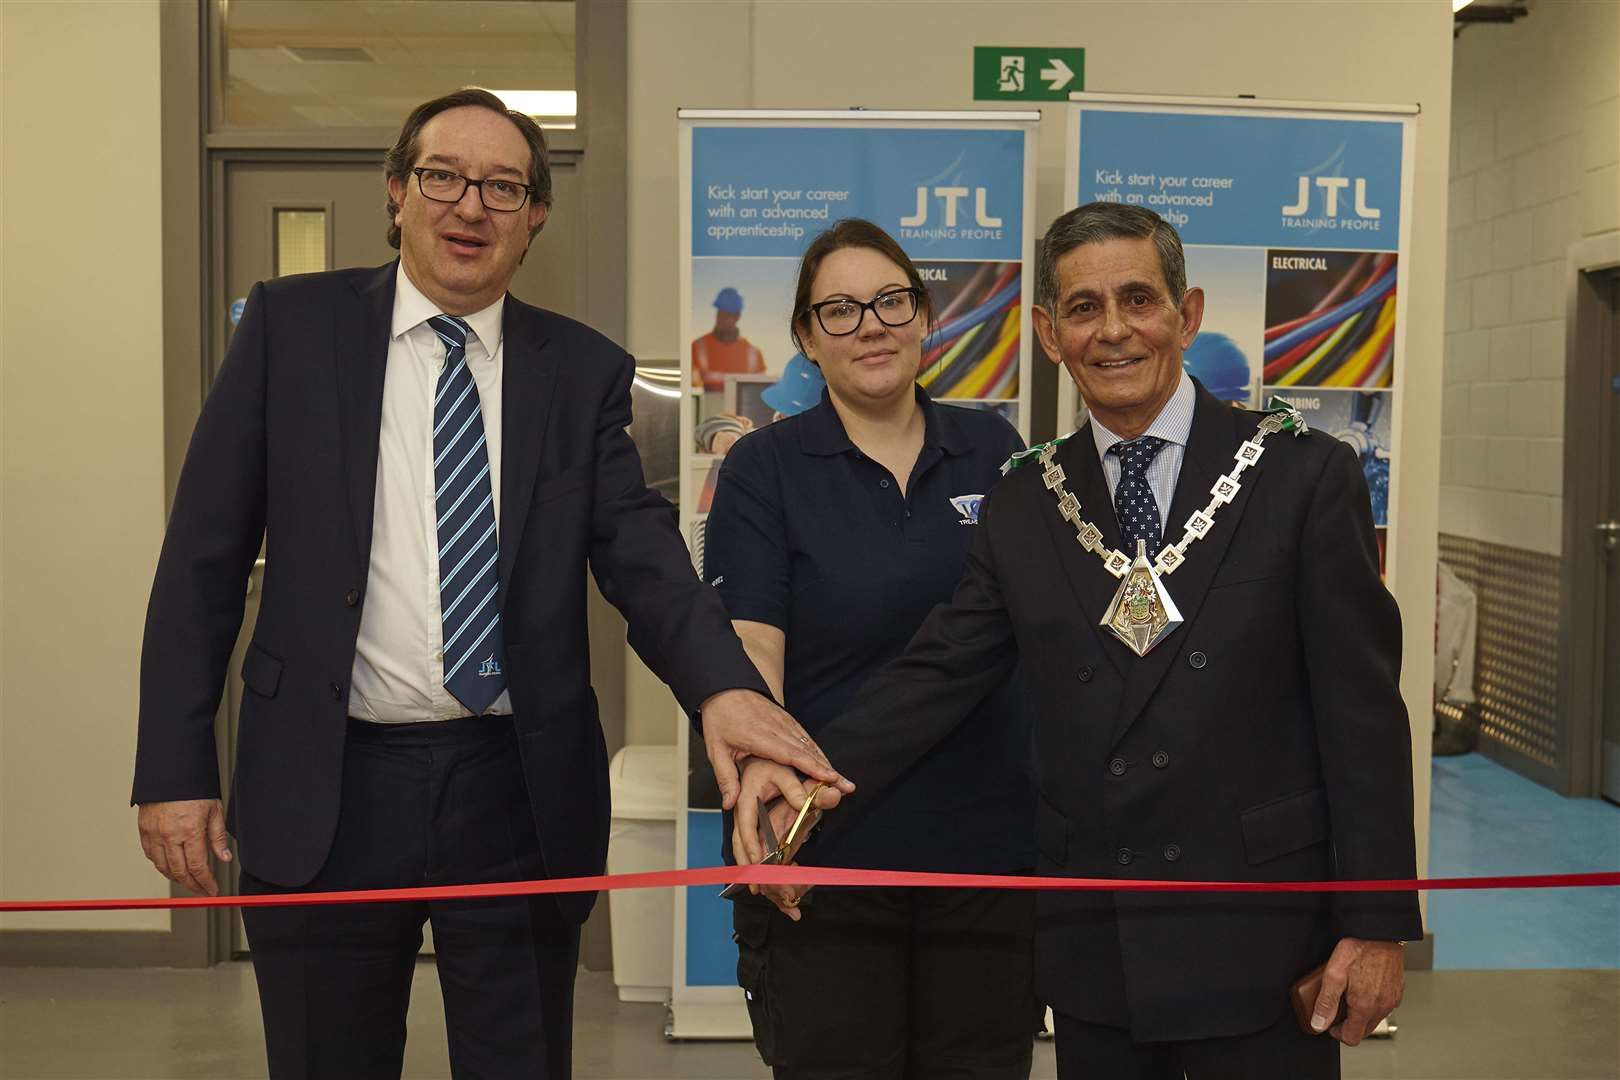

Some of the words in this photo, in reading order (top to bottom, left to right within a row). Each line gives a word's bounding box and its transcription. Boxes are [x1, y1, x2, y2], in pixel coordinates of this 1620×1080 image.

[1095, 169, 1123, 185] Kick
[1128, 173, 1156, 186] start
[1159, 176, 1187, 190] your
[1192, 177, 1234, 188] career
[708, 184, 736, 200] Kick
[741, 187, 768, 200] start
[772, 190, 801, 204] your
[806, 190, 849, 200] career
[1095, 188, 1121, 202] with
[1126, 193, 1143, 204] an
[1148, 191, 1213, 206] advanced
[1282, 176, 1380, 218] JTL
[708, 204, 735, 217] with
[740, 208, 757, 217] an
[762, 203, 828, 219] advanced
[900, 187, 1002, 227] JTL
[707, 223, 804, 240] apprenticeship
[1282, 218, 1337, 229] TRAINING
[1341, 219, 1380, 230] PEOPLE
[900, 229, 956, 239] TRAINING
[961, 229, 1003, 239] PEOPLE
[1273, 257, 1327, 270] ELECTRICAL
[917, 268, 948, 280] RICAL
